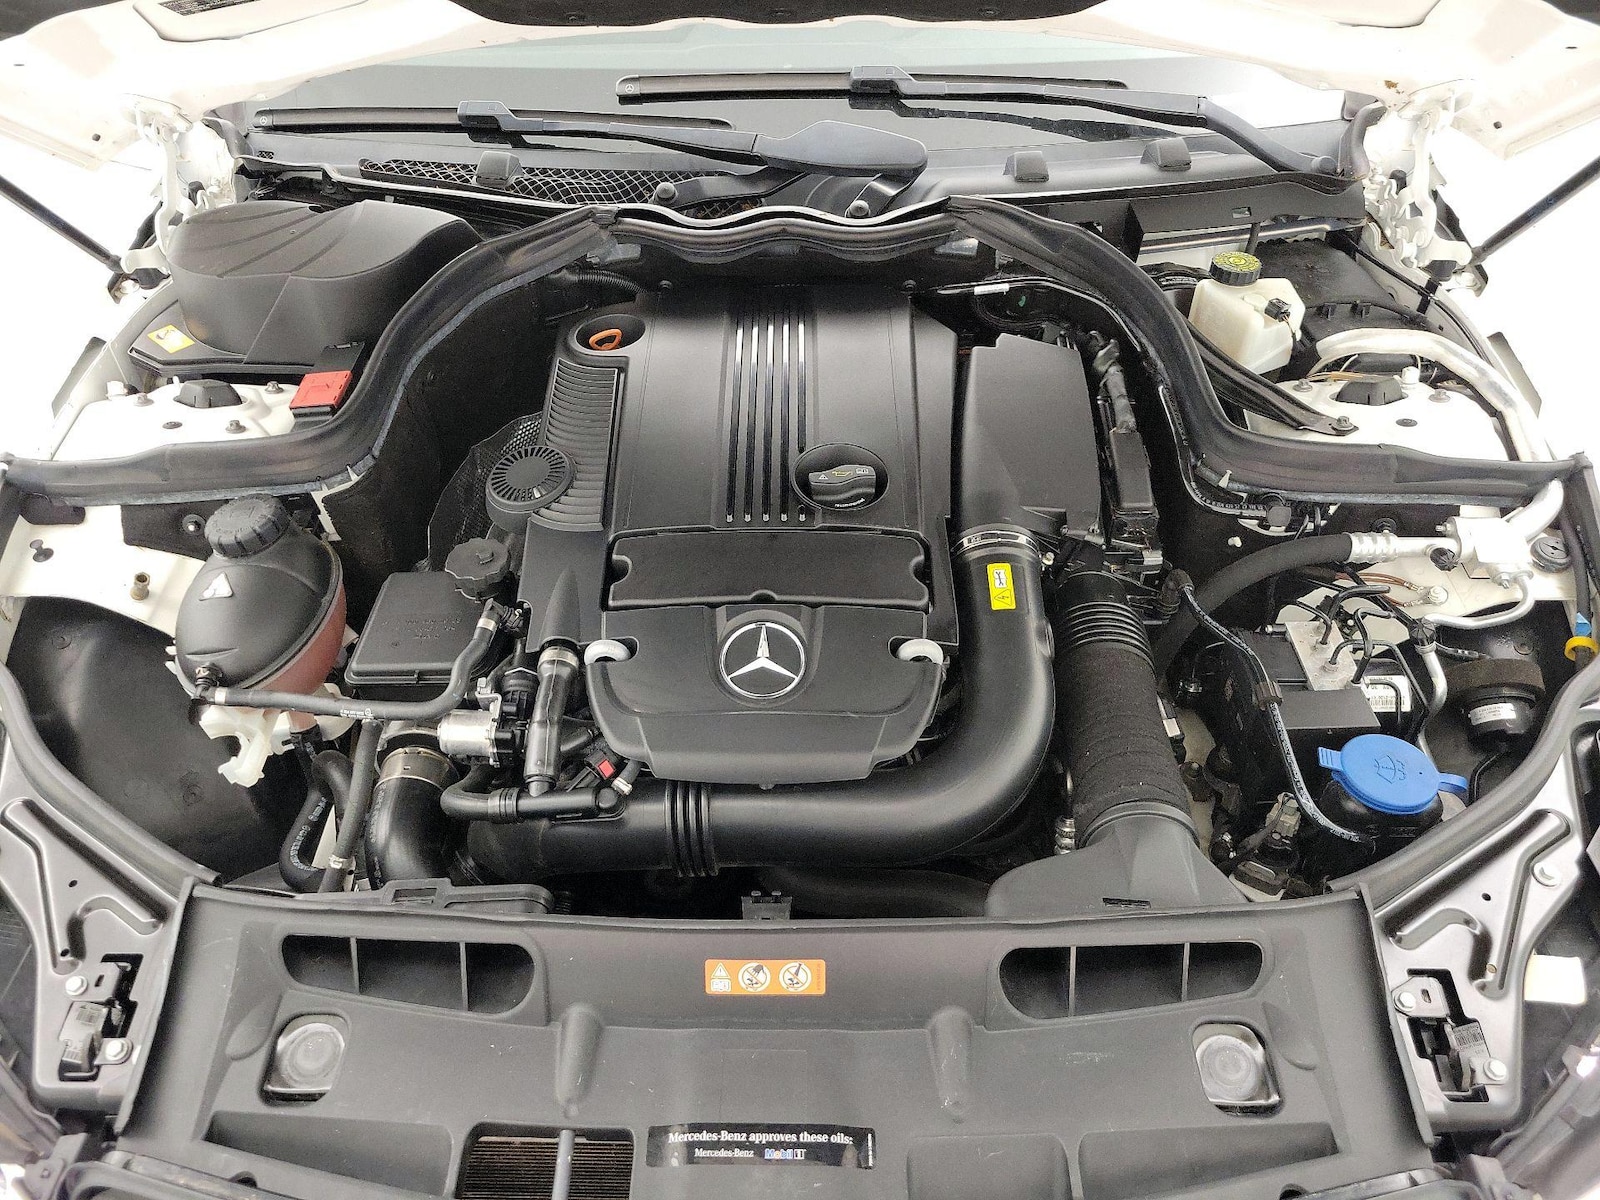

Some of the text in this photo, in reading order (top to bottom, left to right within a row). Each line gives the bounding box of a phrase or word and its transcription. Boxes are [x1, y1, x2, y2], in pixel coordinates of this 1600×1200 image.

[668, 1130, 854, 1144] Mercedes-Benz approves these oils:
[694, 1148, 754, 1157] Mercedes-Benz
[764, 1148, 794, 1159] Mobil
